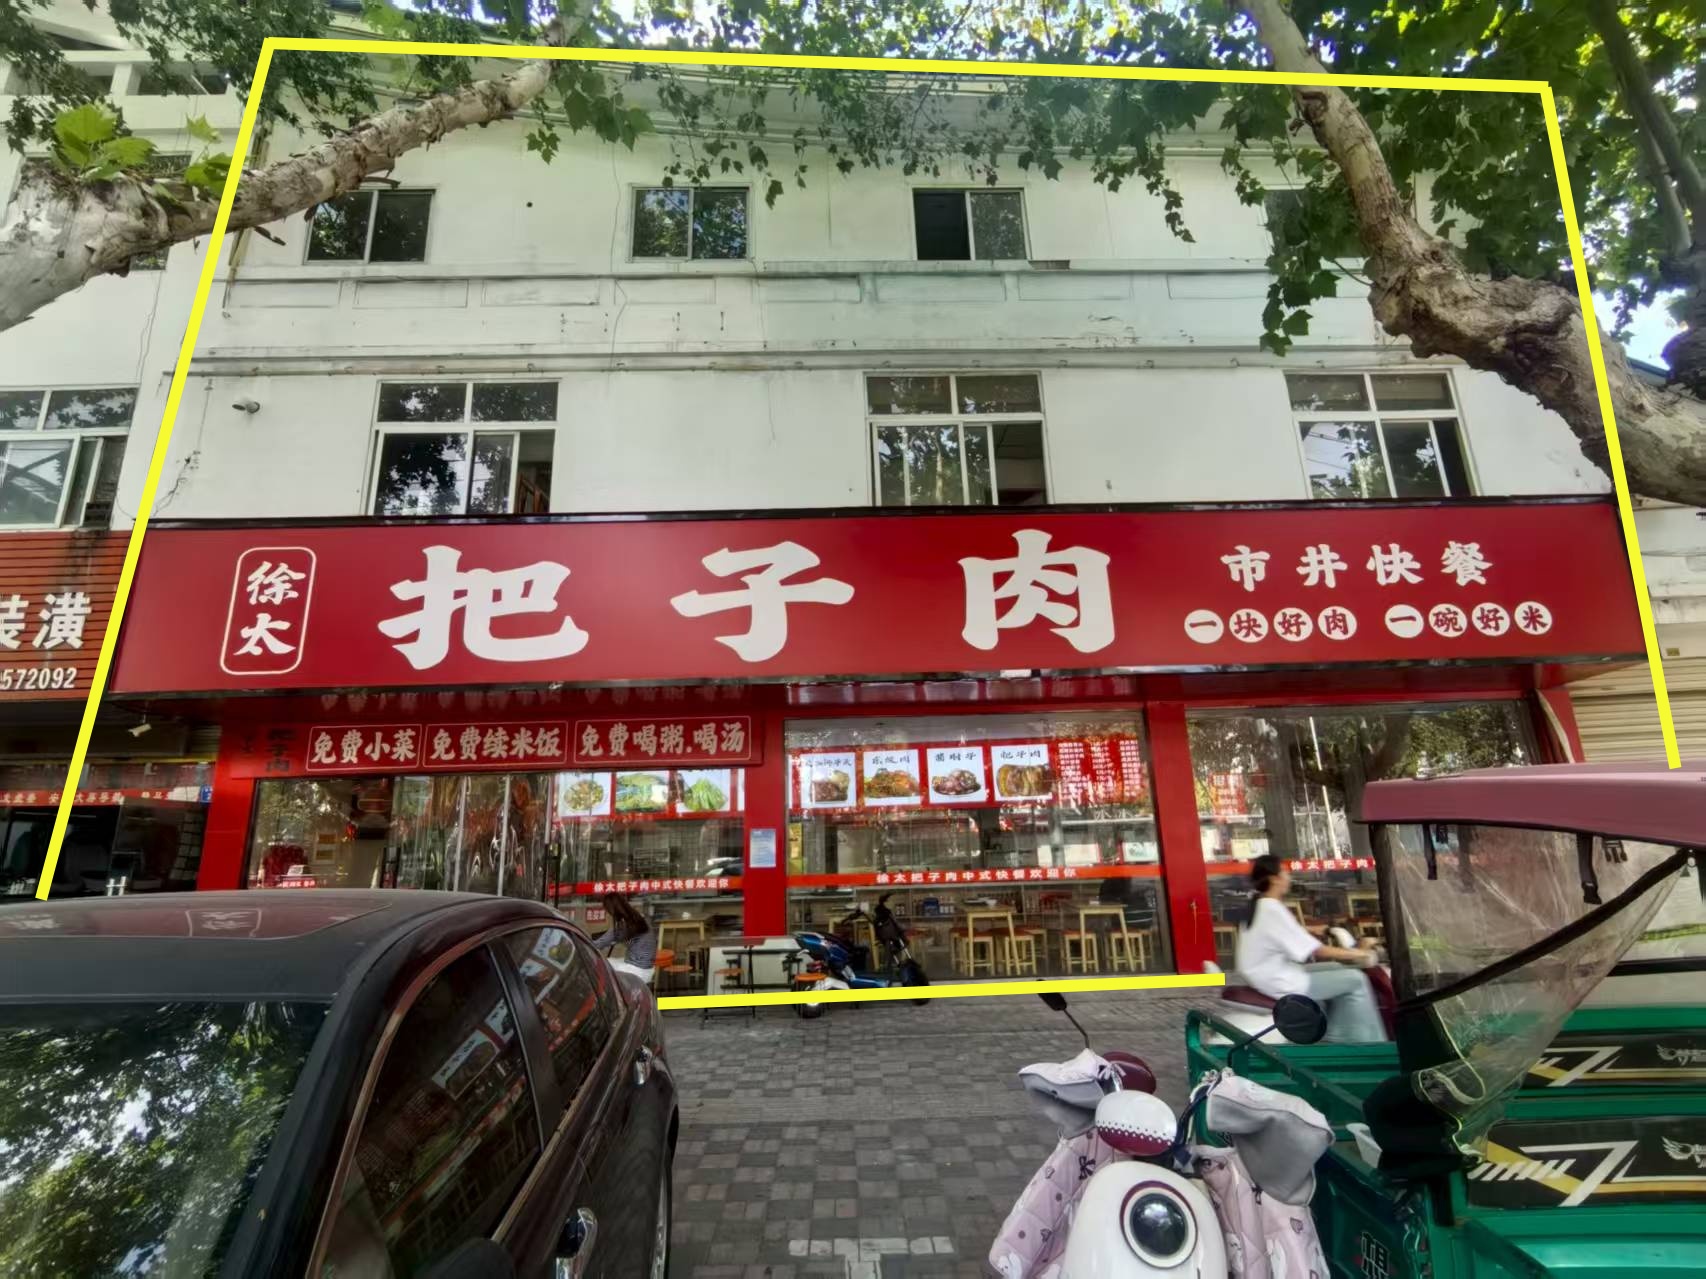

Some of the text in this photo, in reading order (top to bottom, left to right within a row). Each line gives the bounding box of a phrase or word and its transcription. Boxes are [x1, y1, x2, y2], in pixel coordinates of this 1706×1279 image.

[1221, 541, 1493, 591] 市井快餐
[234, 561, 306, 657] 徐太
[378, 529, 1117, 671] 把子肉
[1184, 602, 1553, 644] 一块好肉 一碗好米
[311, 728, 416, 764] 免费小菜
[431, 727, 562, 761] 免费续米饭
[1290, 858, 1375, 871] 徐太把子肉
